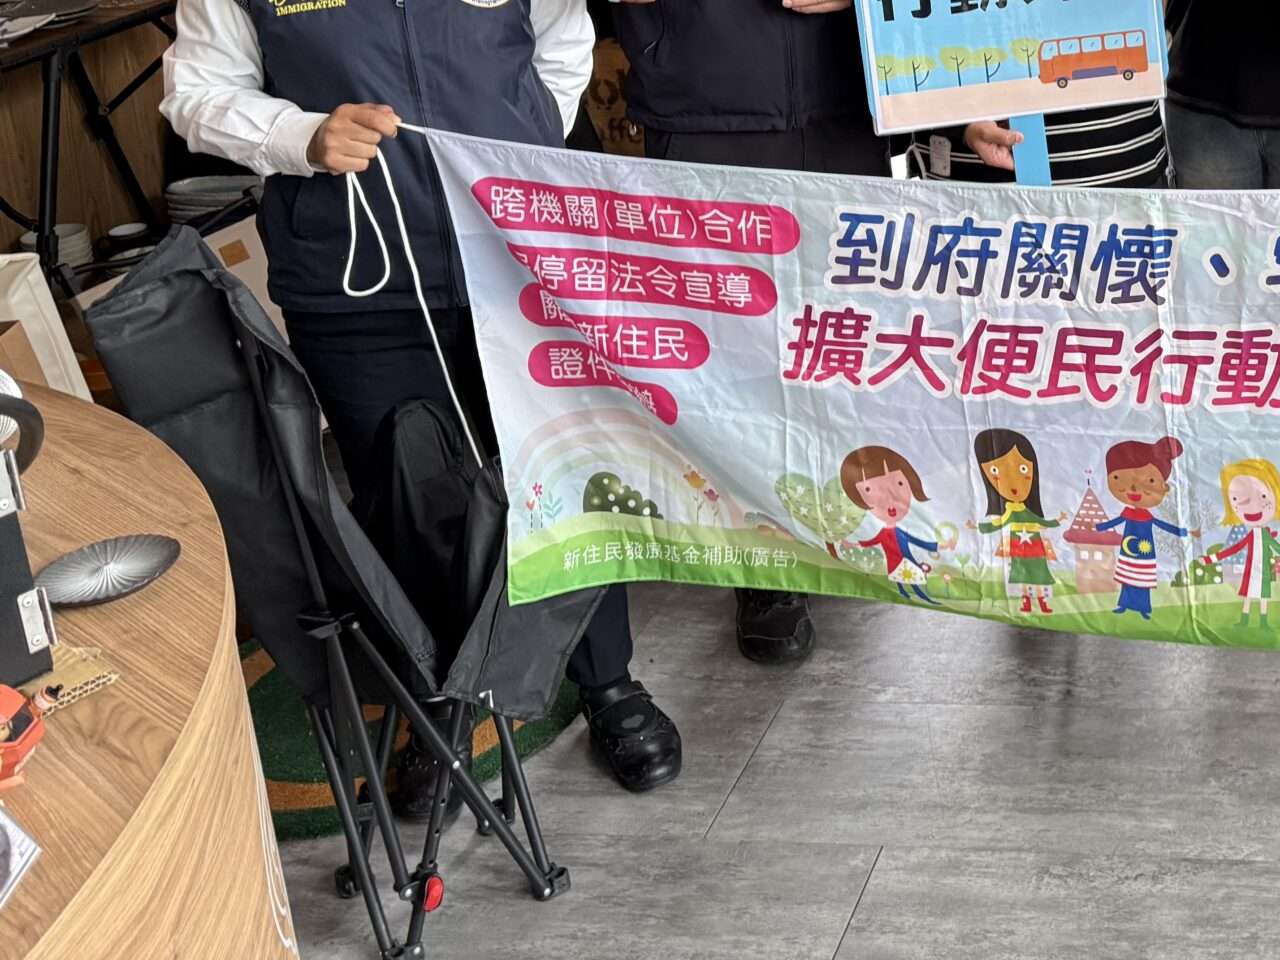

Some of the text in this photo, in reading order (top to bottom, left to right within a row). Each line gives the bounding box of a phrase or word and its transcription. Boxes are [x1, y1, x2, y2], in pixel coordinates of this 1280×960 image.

[490, 185, 772, 248] 跨機關(單位)合作
[513, 251, 753, 308] 停留法令宣導
